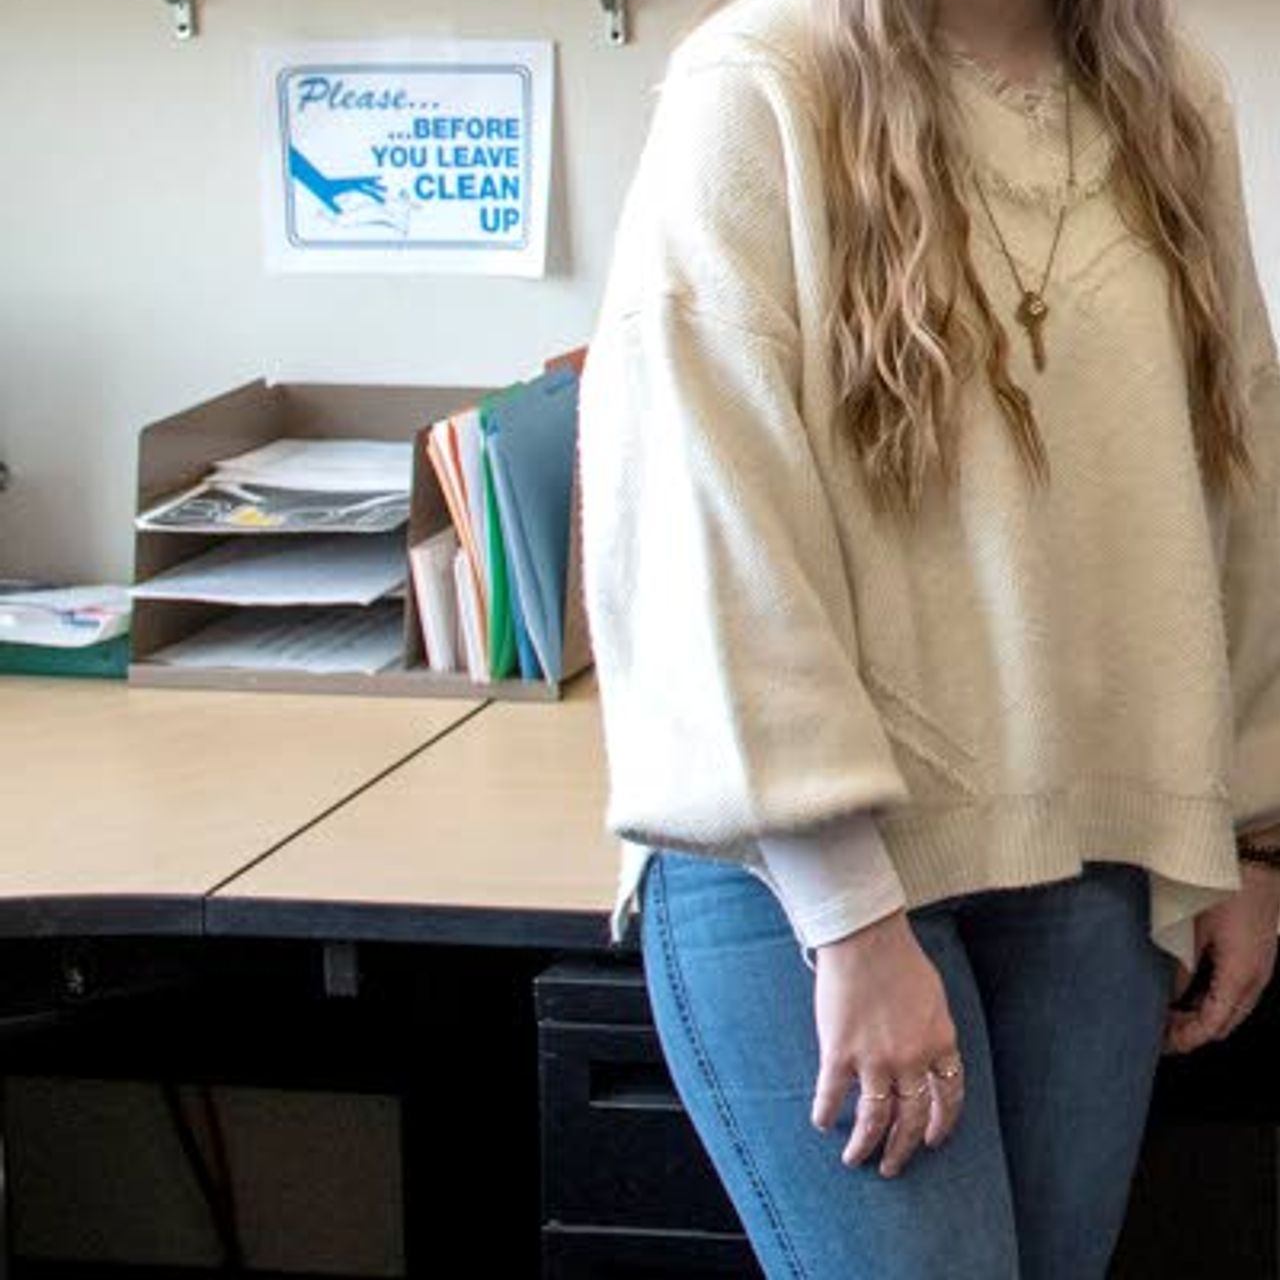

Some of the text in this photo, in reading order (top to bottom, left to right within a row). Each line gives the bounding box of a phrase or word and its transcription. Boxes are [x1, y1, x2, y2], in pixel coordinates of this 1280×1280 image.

[371, 147, 520, 168] YOU LEAVE
[414, 175, 520, 200] CLEAN
[479, 208, 521, 233] UP
